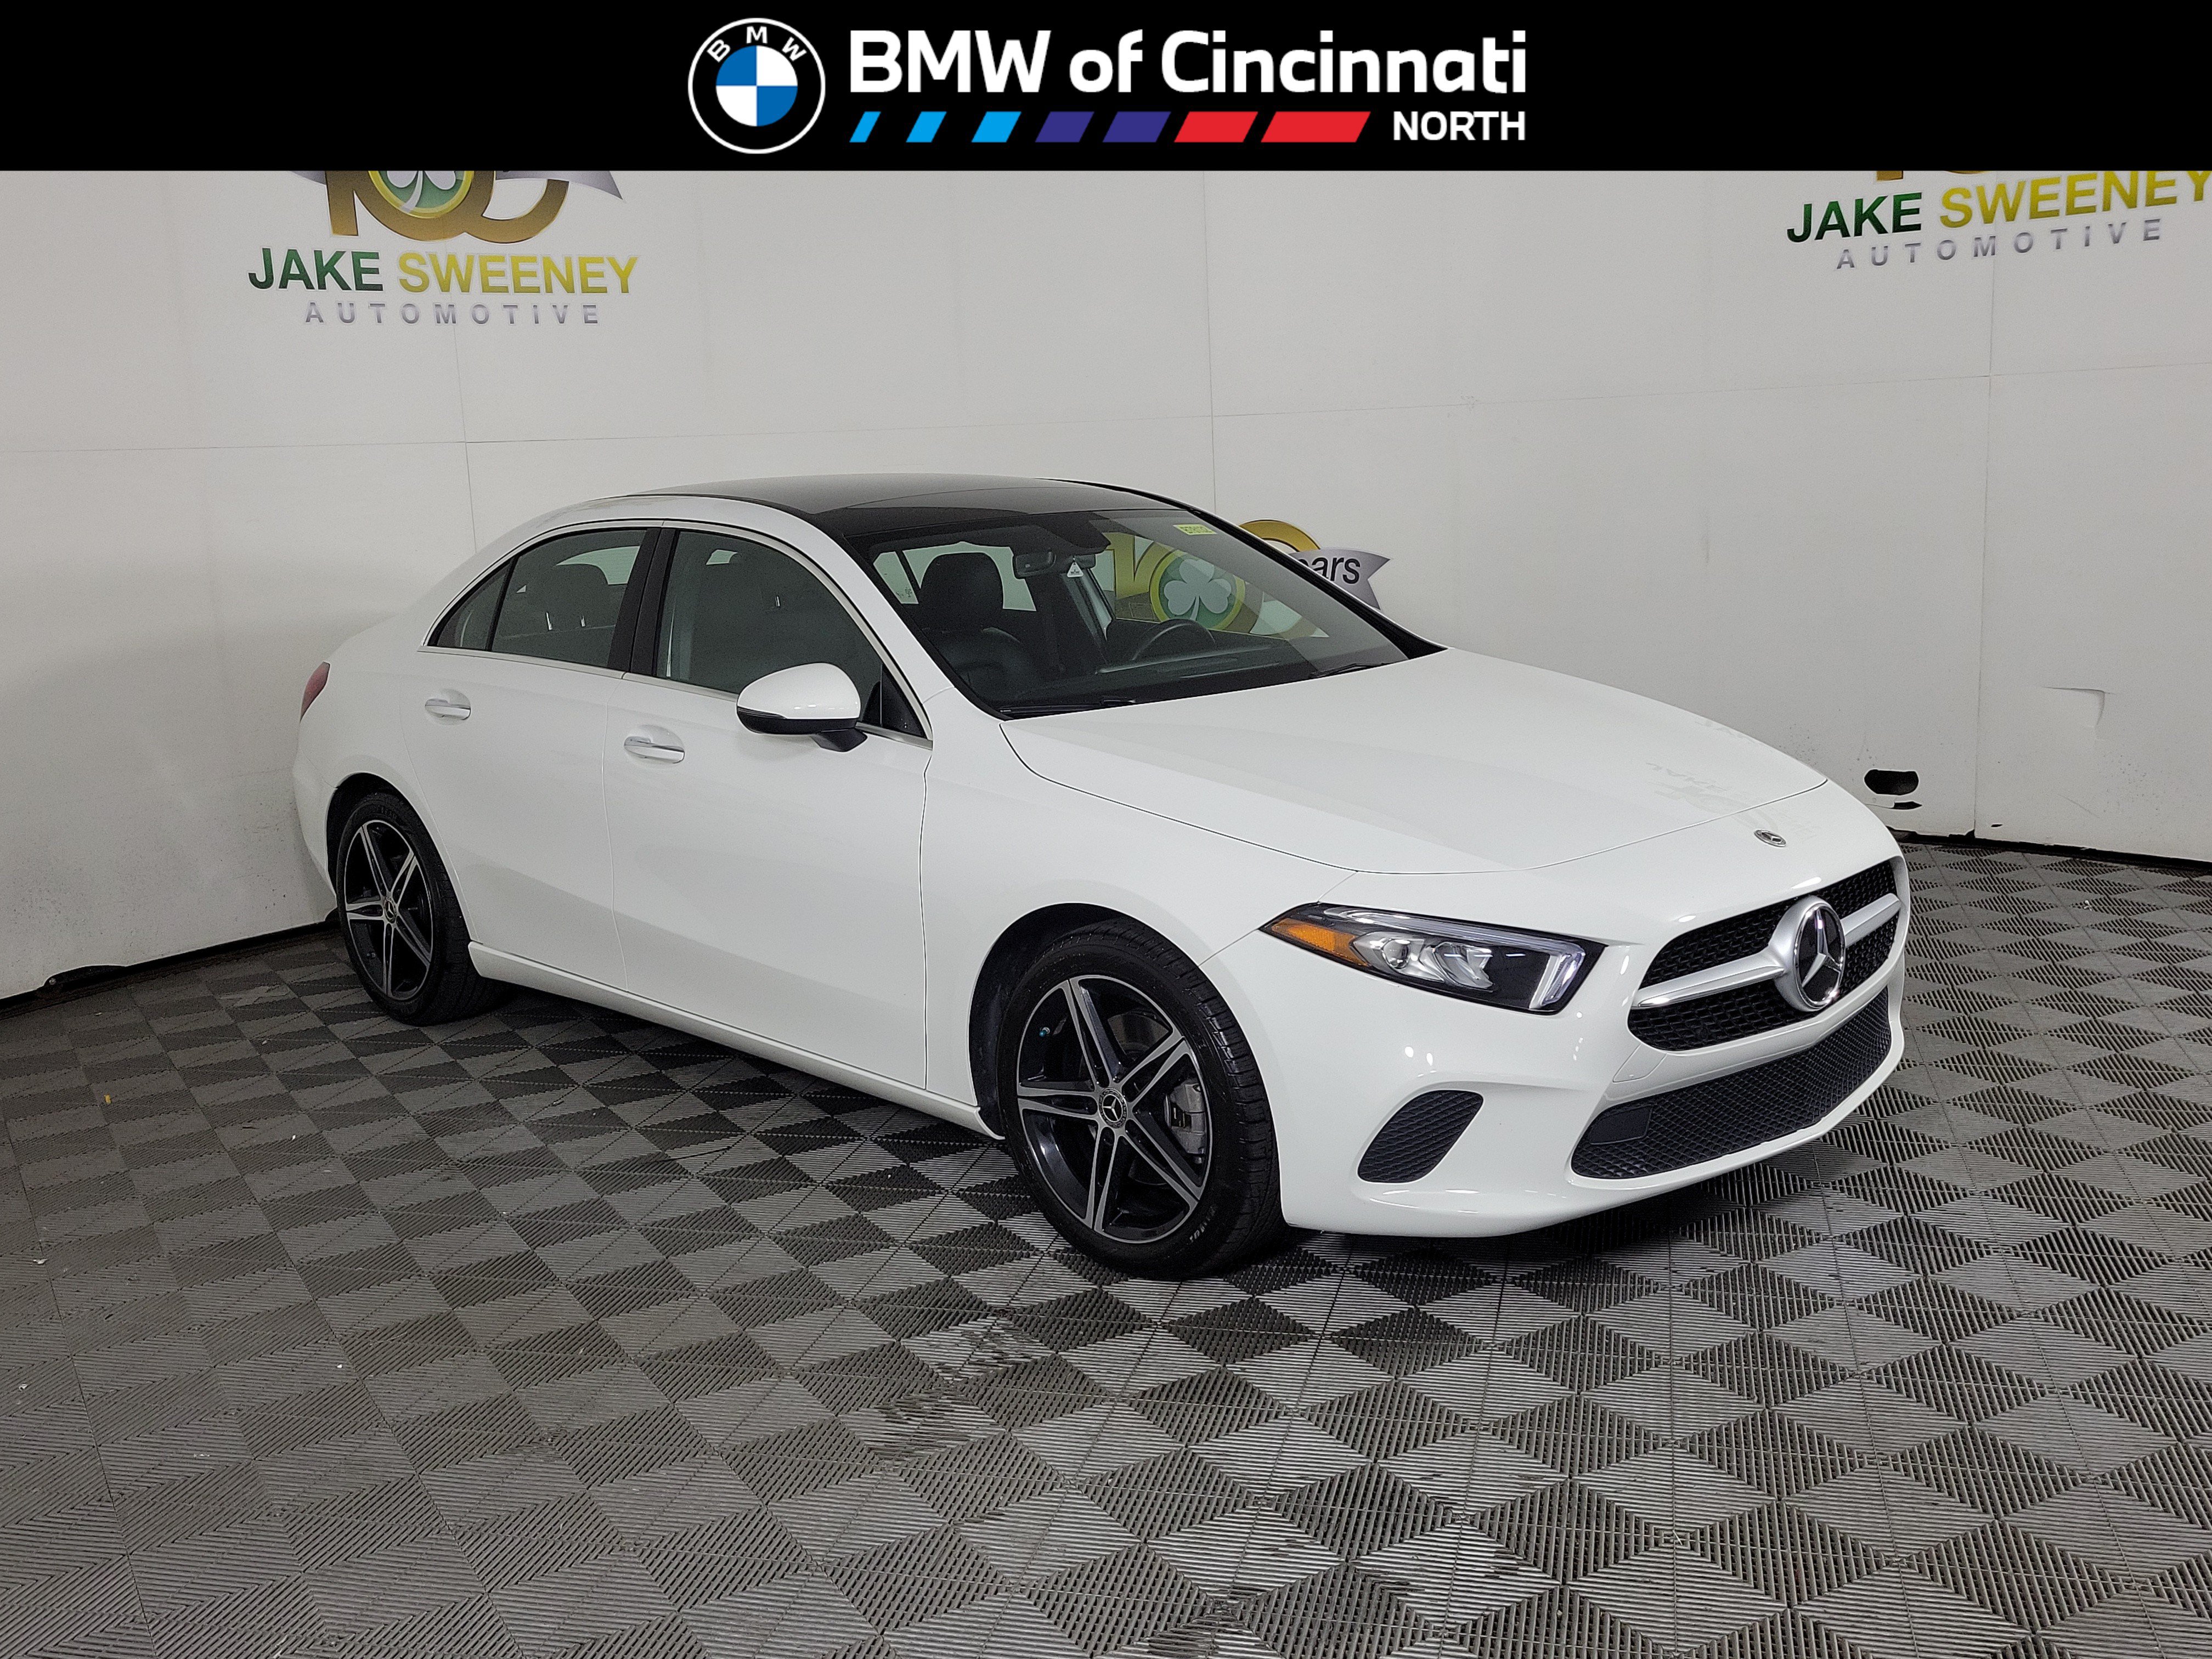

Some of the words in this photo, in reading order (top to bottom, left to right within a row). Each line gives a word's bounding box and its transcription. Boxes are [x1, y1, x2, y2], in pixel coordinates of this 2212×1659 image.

[1787, 193, 1923, 244] JAKE
[1837, 218, 2162, 270] AUTOMOTIVE
[249, 248, 384, 291] JAKE
[399, 253, 639, 294] SWEENEY
[305, 302, 600, 325] AUTOMOTIVE
